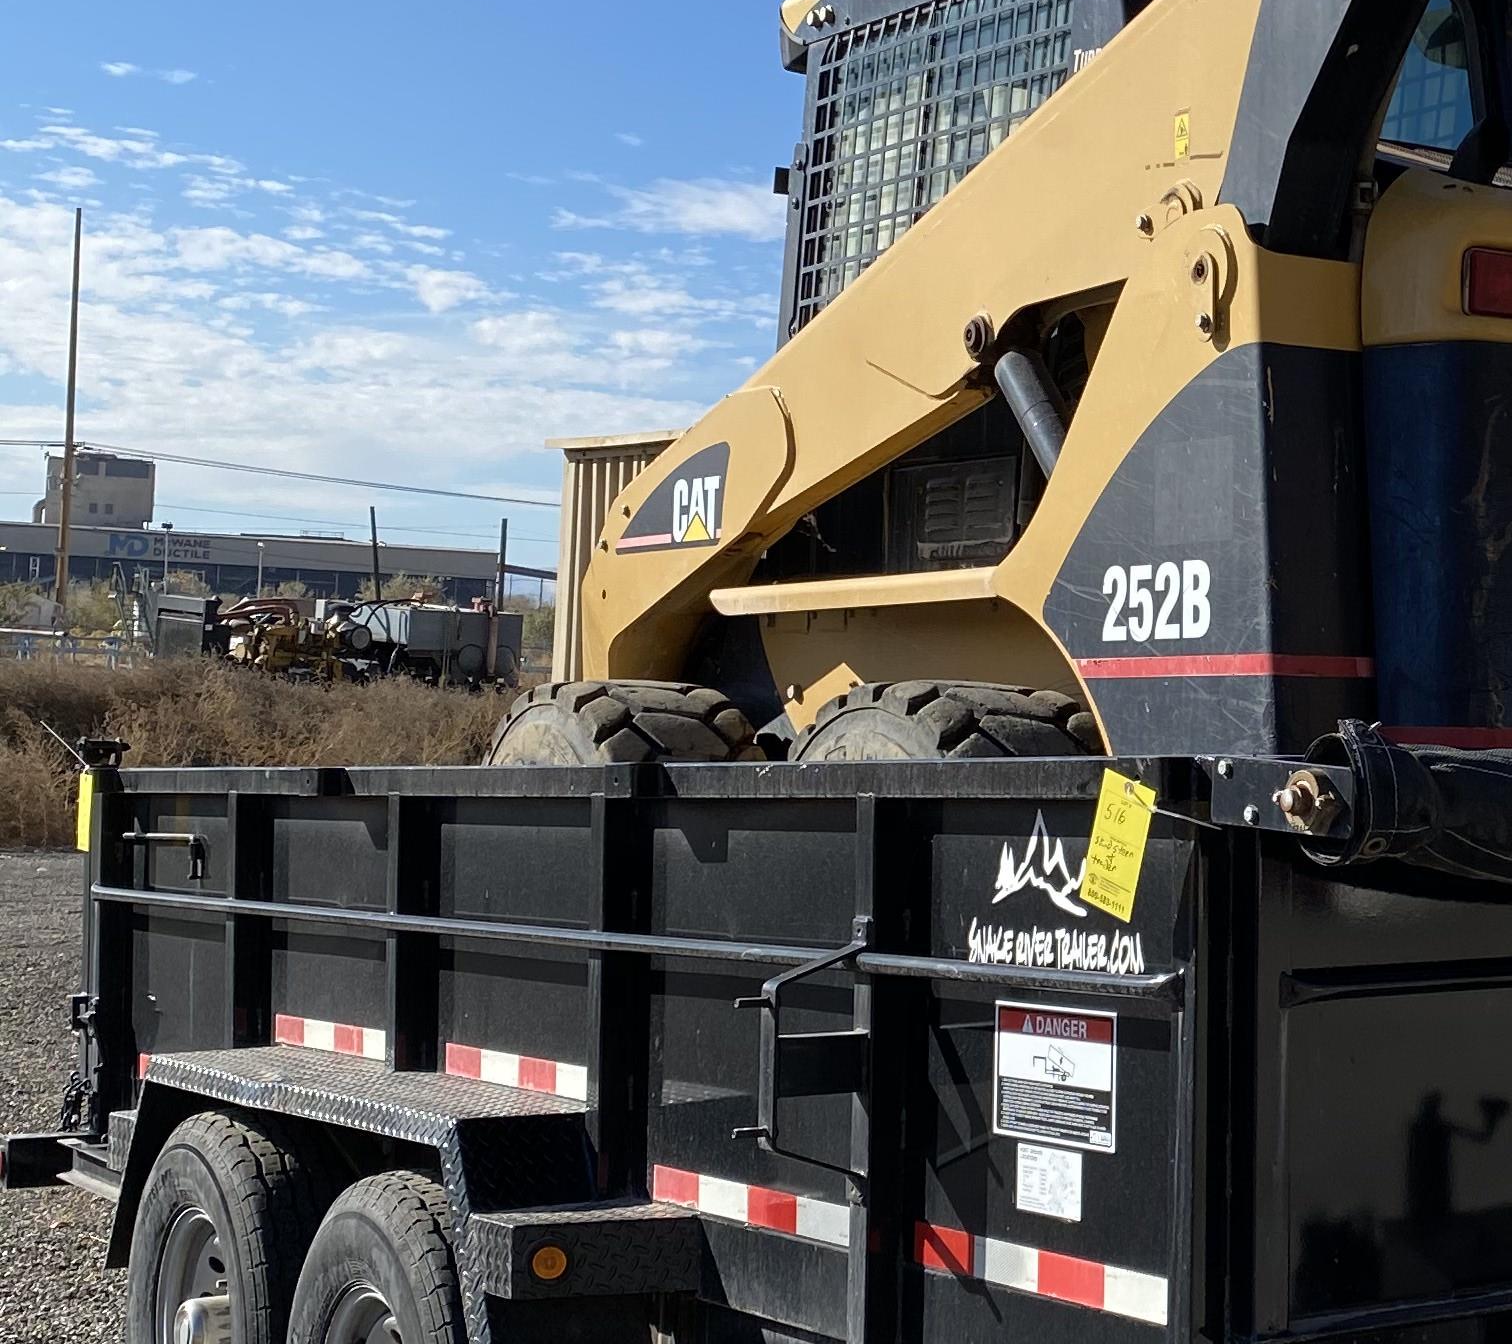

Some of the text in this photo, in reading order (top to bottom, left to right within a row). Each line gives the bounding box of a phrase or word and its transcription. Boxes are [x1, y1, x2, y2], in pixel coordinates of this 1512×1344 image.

[673, 475, 720, 544] CAT
[153, 547, 211, 560] DUCTILE
[1102, 559, 1211, 642] 252B
[1104, 803, 1127, 825] 516
[1035, 1016, 1088, 1040] DANGER
